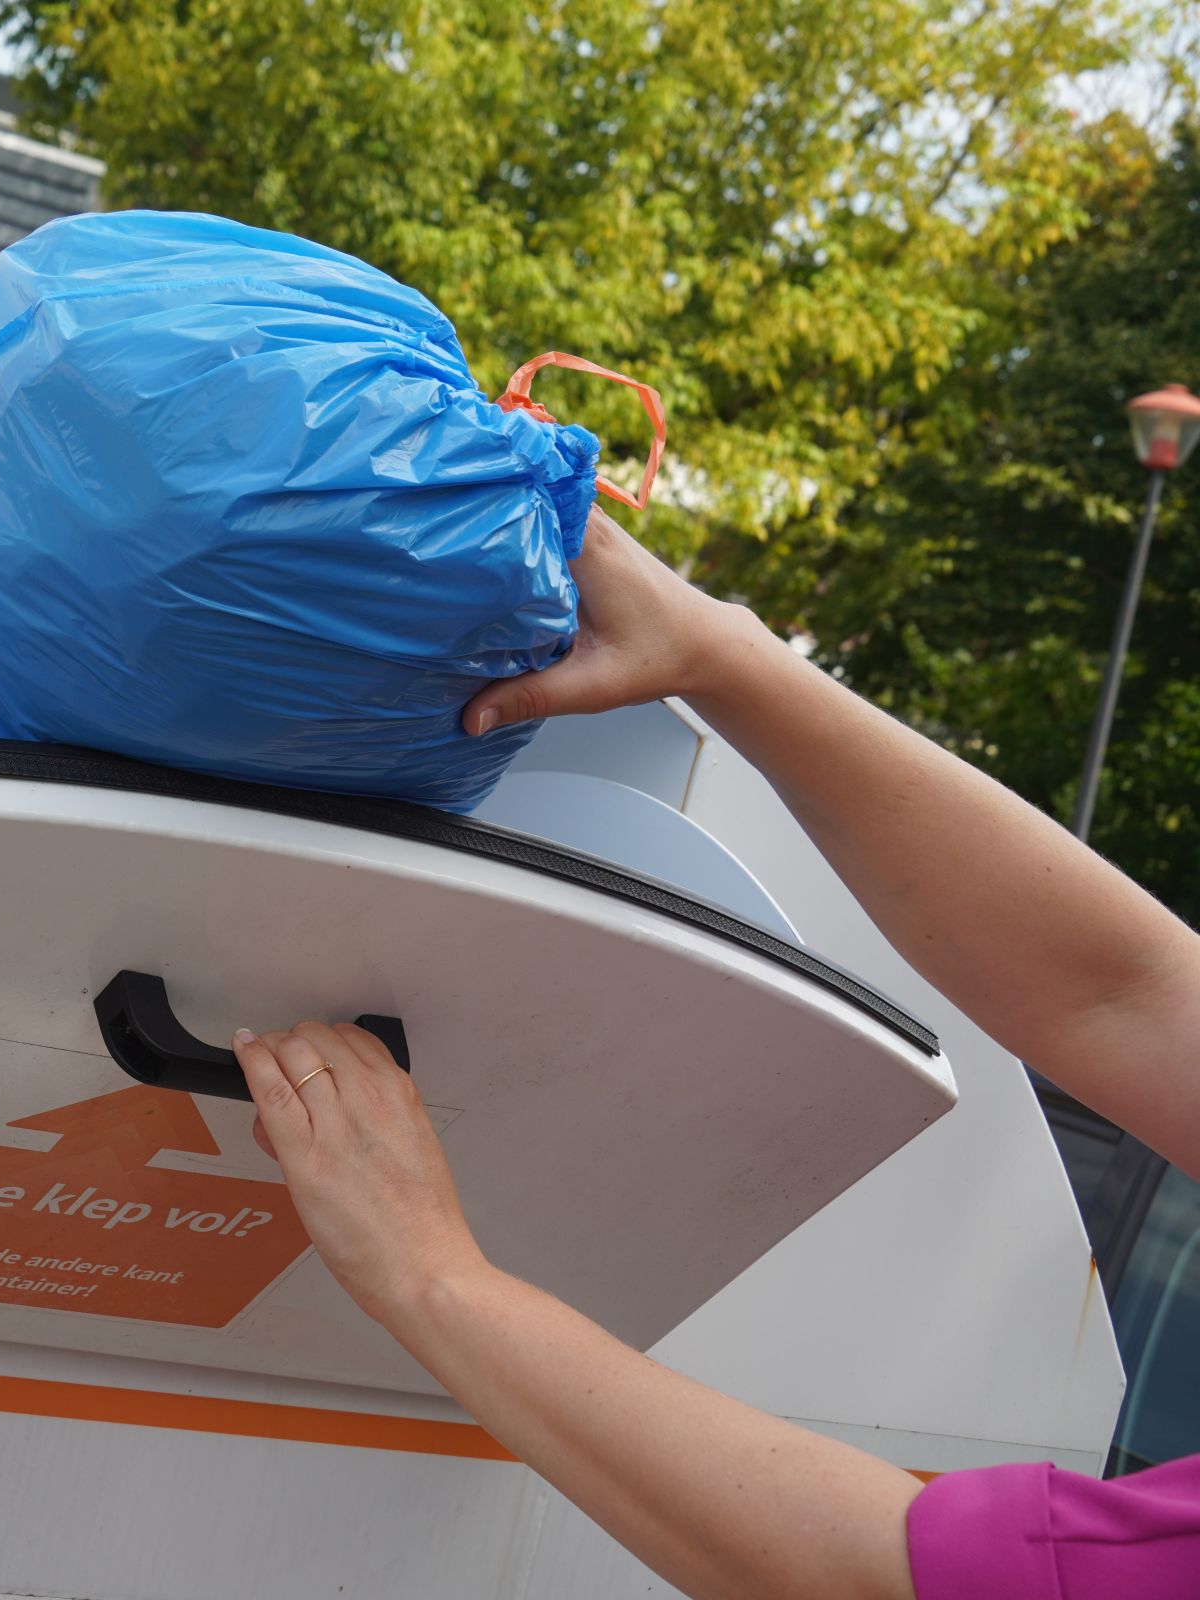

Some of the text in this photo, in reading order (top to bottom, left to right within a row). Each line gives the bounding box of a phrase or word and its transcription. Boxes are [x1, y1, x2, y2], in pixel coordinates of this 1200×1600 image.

[32, 1182, 153, 1231] klep
[163, 1207, 273, 1238] vol?
[25, 1253, 119, 1278] andere
[122, 1263, 185, 1285] kant
